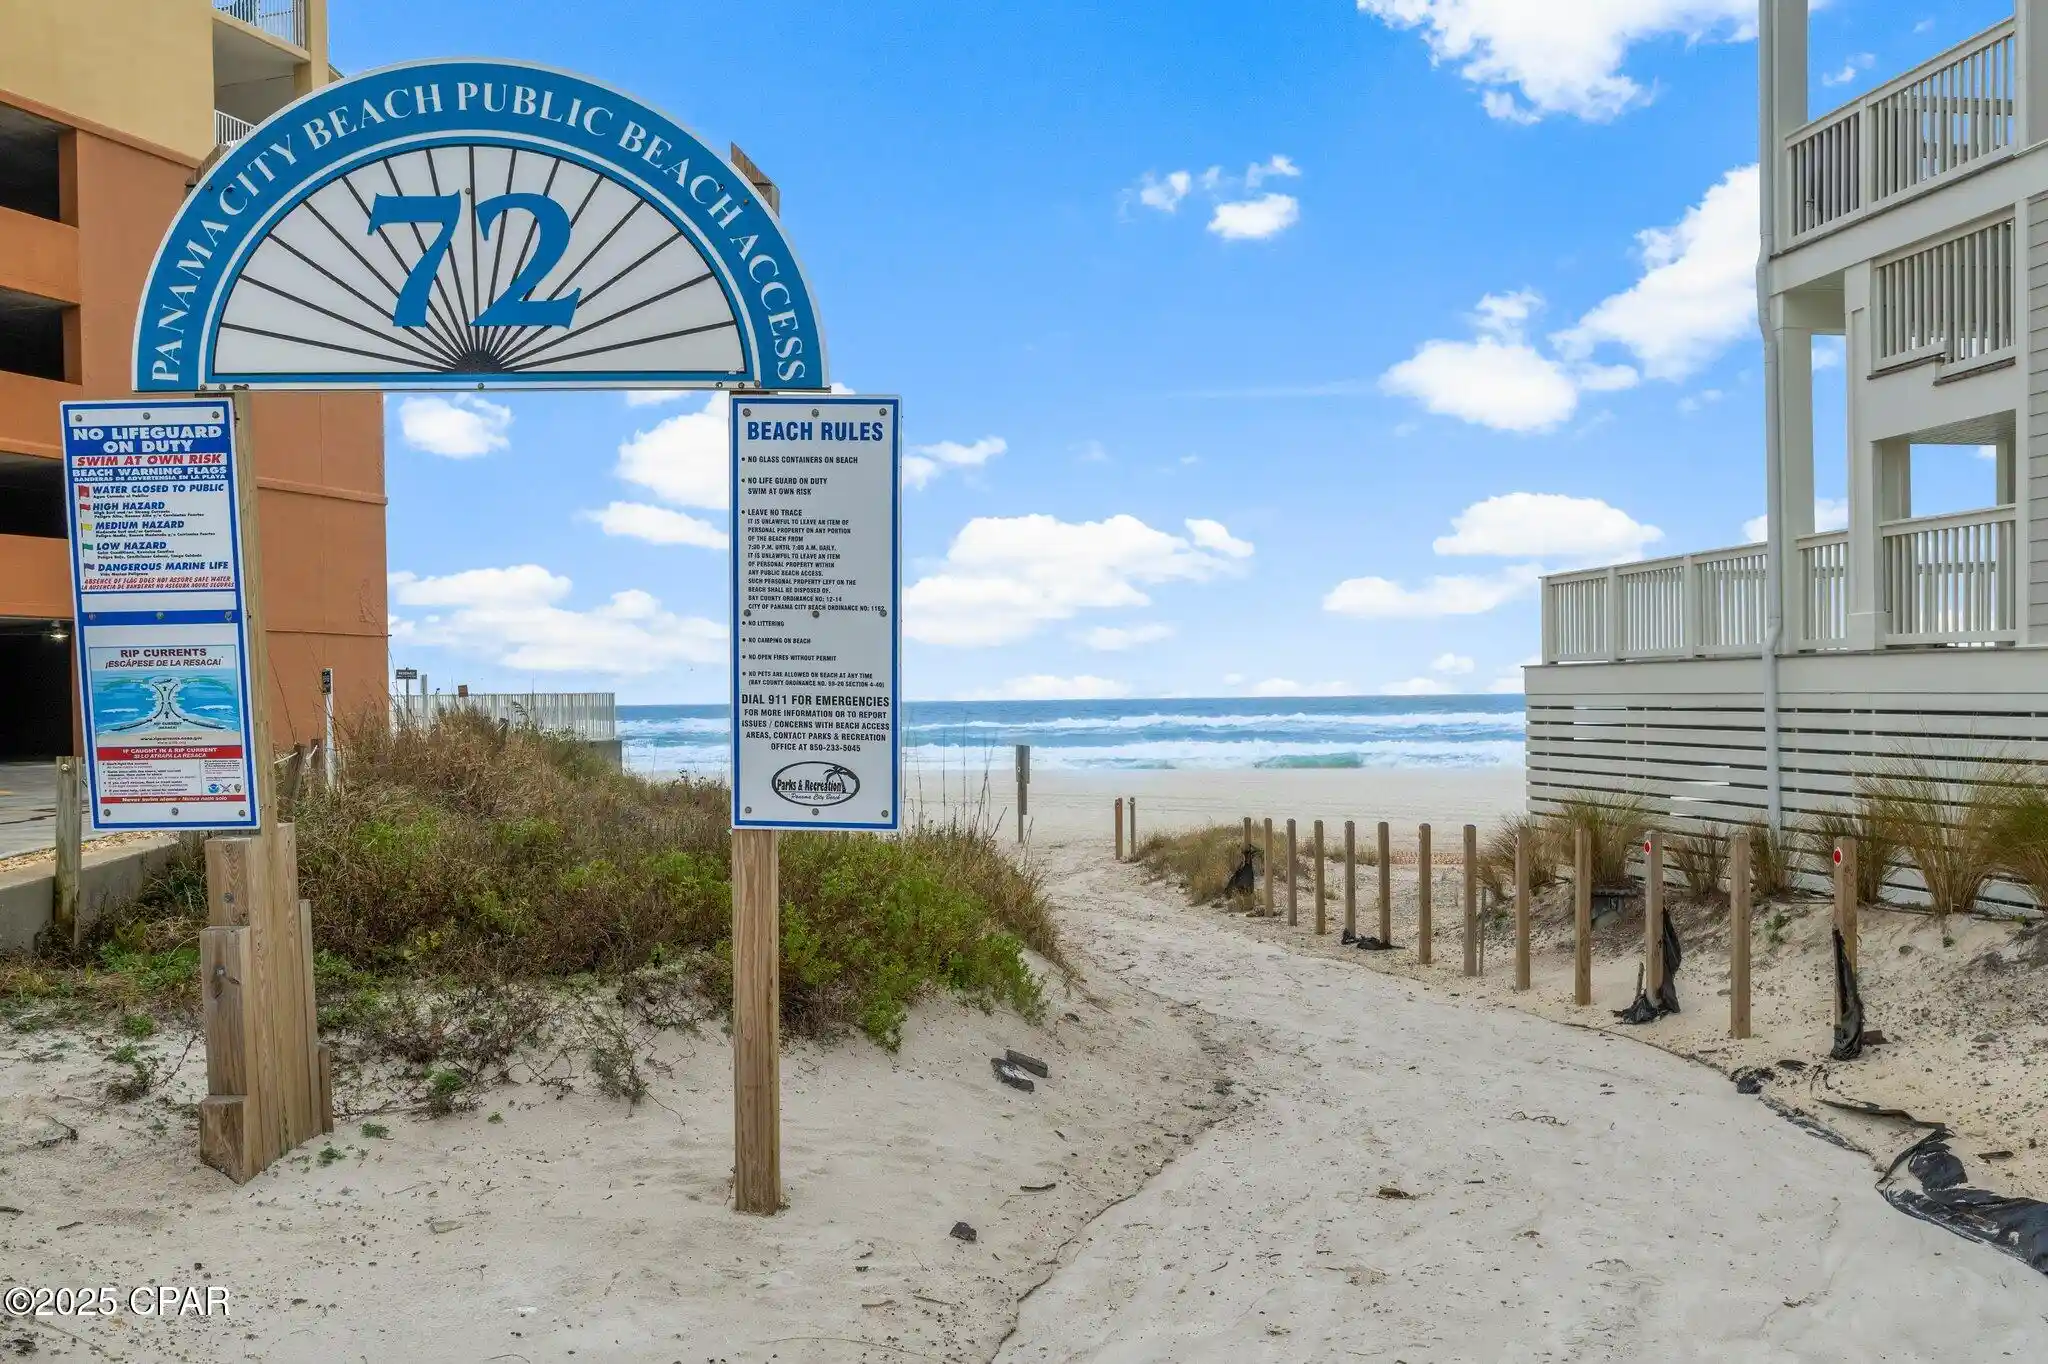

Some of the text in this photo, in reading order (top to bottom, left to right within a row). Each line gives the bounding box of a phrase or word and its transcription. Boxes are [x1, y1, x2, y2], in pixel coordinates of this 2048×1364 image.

[152, 82, 806, 382] PANAMA CITY BEACH PUBLIC BEACH ACCESS
[367, 189, 583, 329] 72
[73, 426, 222, 441] NO LIFEGUARD
[748, 422, 883, 441] BEACH RULES
[103, 440, 193, 453] ON DUTY
[78, 454, 221, 466] SWIM AT OWN RISK
[98, 562, 161, 571] DANGEROUS
[144, 648, 206, 657] CURRENTS
[156, 659, 168, 667] DE
[170, 659, 181, 667] LA
[742, 694, 889, 707] DIAL 911 FOR EMERGENCIES
[784, 709, 832, 718] INFORMATION
[859, 711, 886, 719] REPORT
[775, 720, 813, 728] CONCERNS
[861, 722, 889, 730] ACCESS
[746, 731, 885, 741] AREAS, CONTACT PARKS & RECREATION
[771, 743, 797, 751] OFFICE
[810, 743, 860, 752] 850-233-5045
[777, 779, 842, 792] Parks & Recreation
